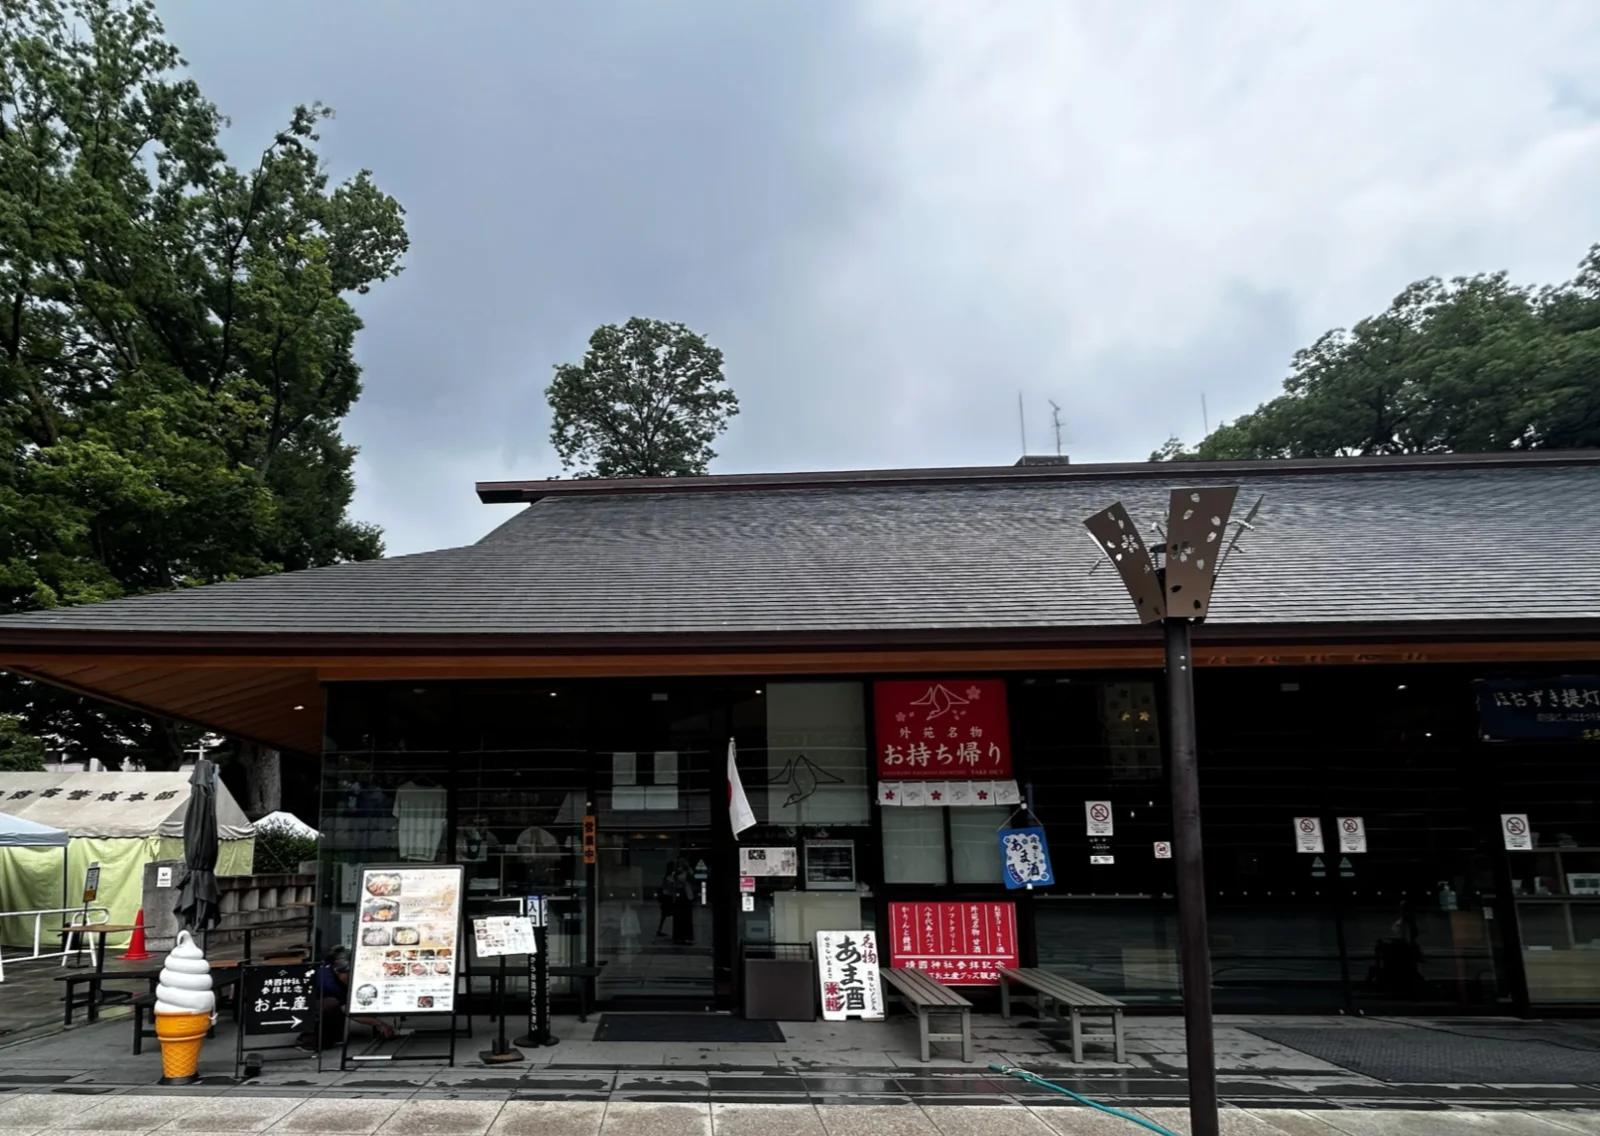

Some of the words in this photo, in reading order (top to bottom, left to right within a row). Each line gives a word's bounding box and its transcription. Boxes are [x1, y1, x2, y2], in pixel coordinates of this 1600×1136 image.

[900, 727, 983, 739] 外苑名物
[884, 742, 1001, 767] お持ち帰り
[585, 821, 594, 858] 営業中
[1011, 838, 1040, 877] あま酒
[528, 901, 537, 925] 入口
[970, 905, 981, 936] 外苑名物
[948, 905, 957, 953] ソフトクリーム
[860, 933, 877, 964] 名物
[835, 934, 866, 1010] あま酒
[254, 995, 309, 1013] お土産
